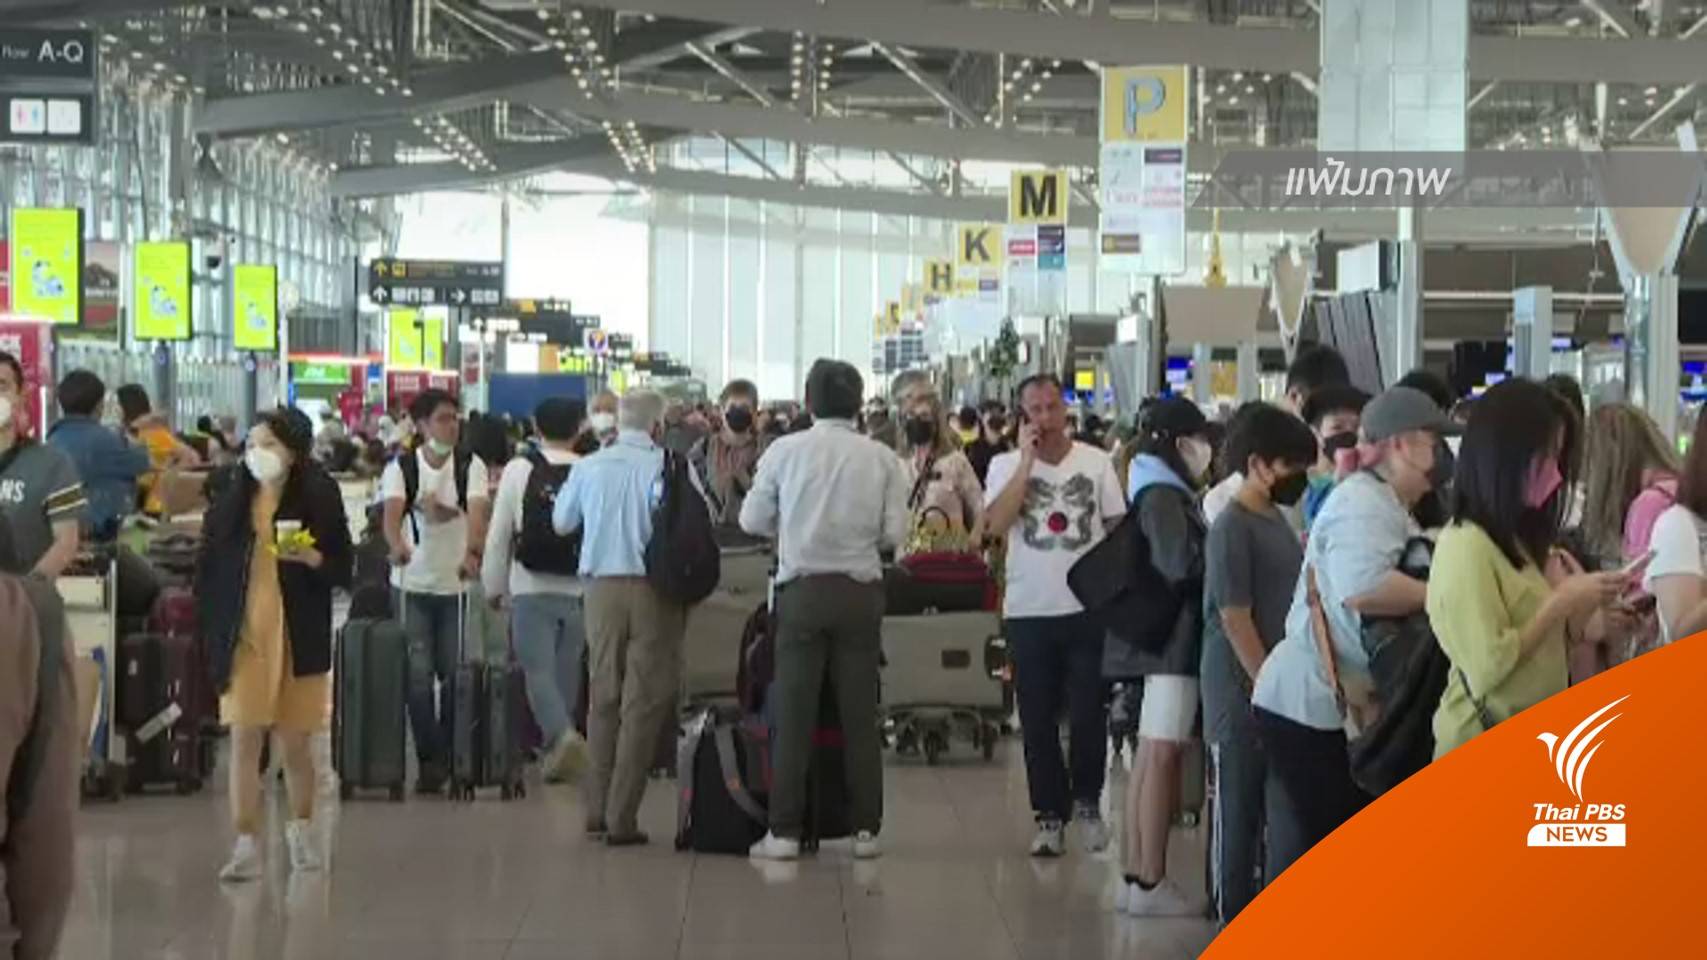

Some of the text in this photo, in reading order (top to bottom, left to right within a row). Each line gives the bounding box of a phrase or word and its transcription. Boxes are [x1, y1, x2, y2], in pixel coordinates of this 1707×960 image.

[38, 39, 83, 62] A-Q
[1124, 76, 1166, 136] P
[1020, 175, 1058, 217] M
[964, 229, 990, 262] K
[931, 263, 951, 291] H
[0, 479, 25, 502] NS
